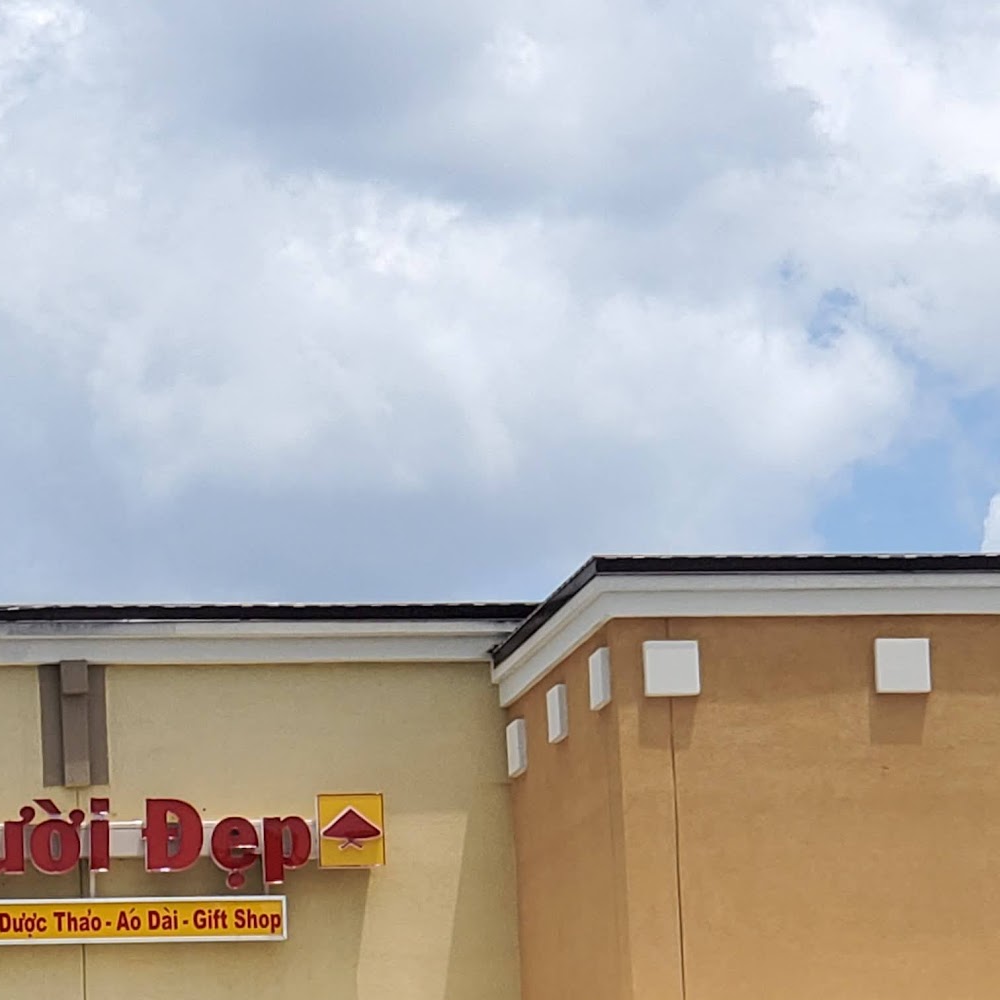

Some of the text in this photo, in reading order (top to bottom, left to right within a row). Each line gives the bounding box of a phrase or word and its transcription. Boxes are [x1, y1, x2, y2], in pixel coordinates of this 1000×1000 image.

[142, 798, 313, 889] Đẹp
[0, 912, 47, 938] Dược
[148, 906, 178, 930] Dài
[193, 908, 228, 930] Gift
[234, 908, 281, 933] Shop
